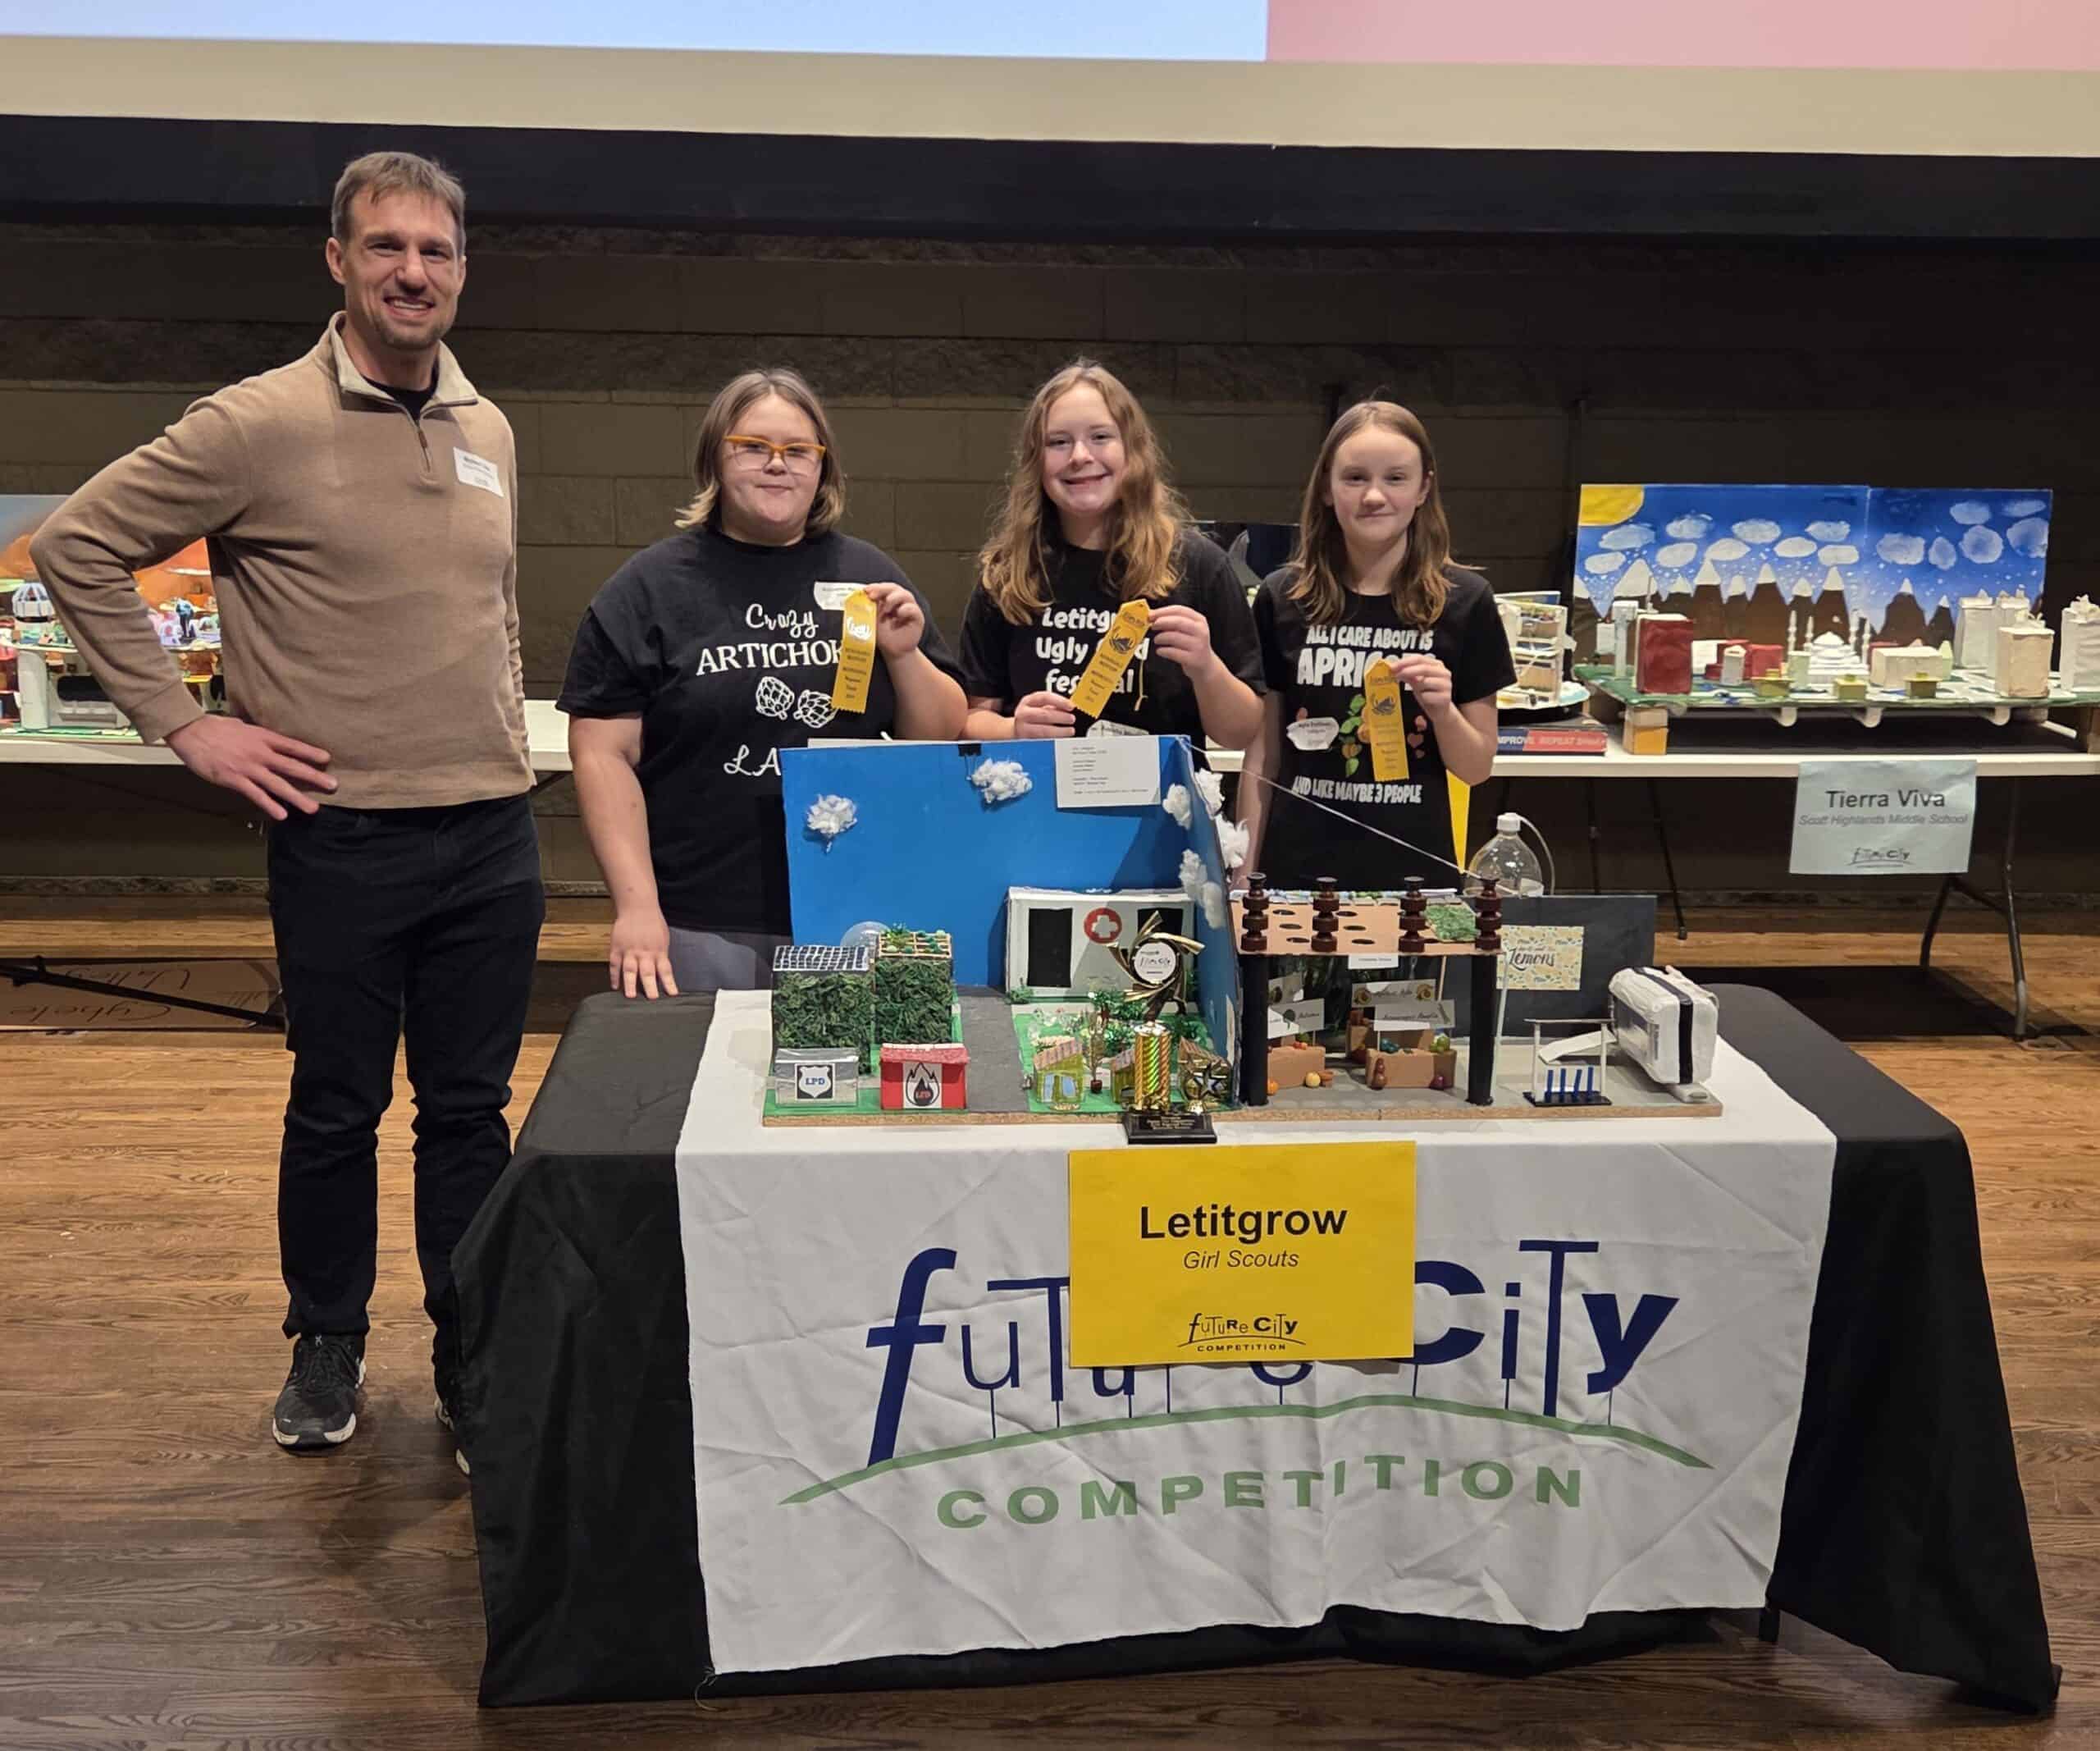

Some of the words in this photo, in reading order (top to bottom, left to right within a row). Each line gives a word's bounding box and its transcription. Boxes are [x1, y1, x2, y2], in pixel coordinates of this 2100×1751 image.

[746, 603, 819, 638] Crazy
[1042, 607, 1116, 633] Letitg
[1036, 637, 1089, 665] Ugly
[1306, 624, 1329, 645] ALL
[1337, 625, 1372, 647] CARE
[1372, 628, 1418, 650] ABOUT
[1419, 630, 1434, 651] IS
[696, 639, 845, 676] ARTICHOK
[1297, 647, 1436, 692] APRI
[1046, 669, 1134, 695] fesal
[1292, 775, 1312, 795] AND
[1312, 778, 1335, 800] LIKE
[1335, 781, 1374, 803] MAYBE
[1375, 783, 1383, 802] 3
[1383, 784, 1423, 804] PEOPLE
[1825, 789, 1889, 808] Tierra
[1897, 789, 1946, 807] Viva
[1888, 813, 1925, 825] Middle
[1929, 812, 1968, 825] School
[1140, 1204, 1348, 1245] Letitgrow
[1183, 1250, 1221, 1270] Girl
[1226, 1249, 1299, 1269] Scouts
[1197, 1343, 1286, 1352] COMPETITION
[937, 1454, 1581, 1529] COMPETITION
